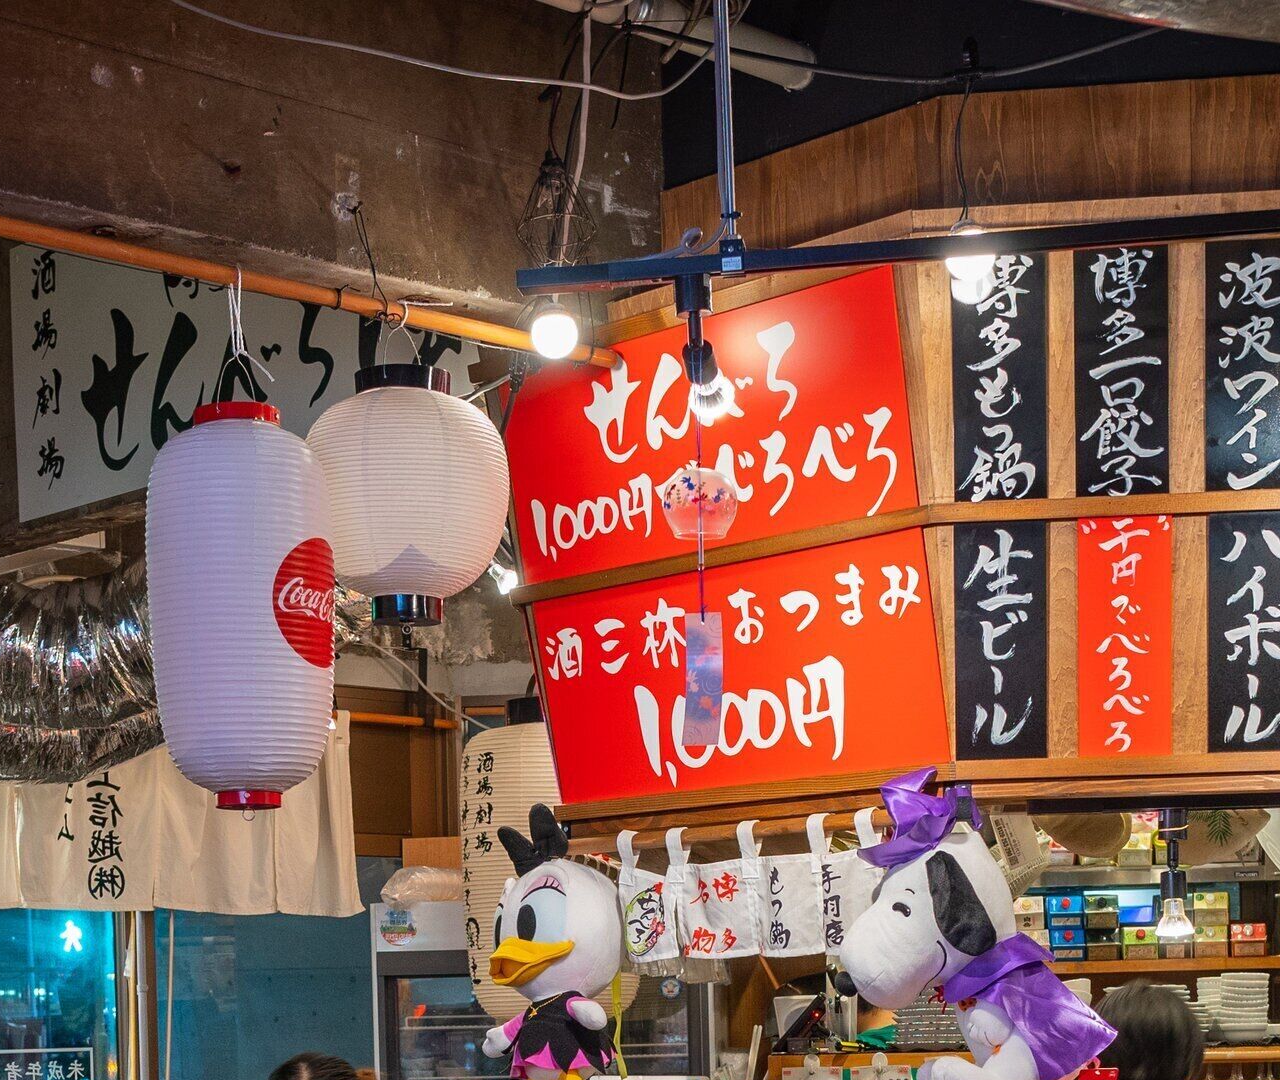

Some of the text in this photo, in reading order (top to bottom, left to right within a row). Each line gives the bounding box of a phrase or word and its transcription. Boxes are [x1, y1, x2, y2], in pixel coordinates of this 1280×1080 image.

[31, 250, 66, 491] 酒場劇場
[1081, 248, 1164, 496] 博多一口餃子
[962, 530, 1035, 746] 生ビール
[474, 751, 495, 857] 酒場劇場
